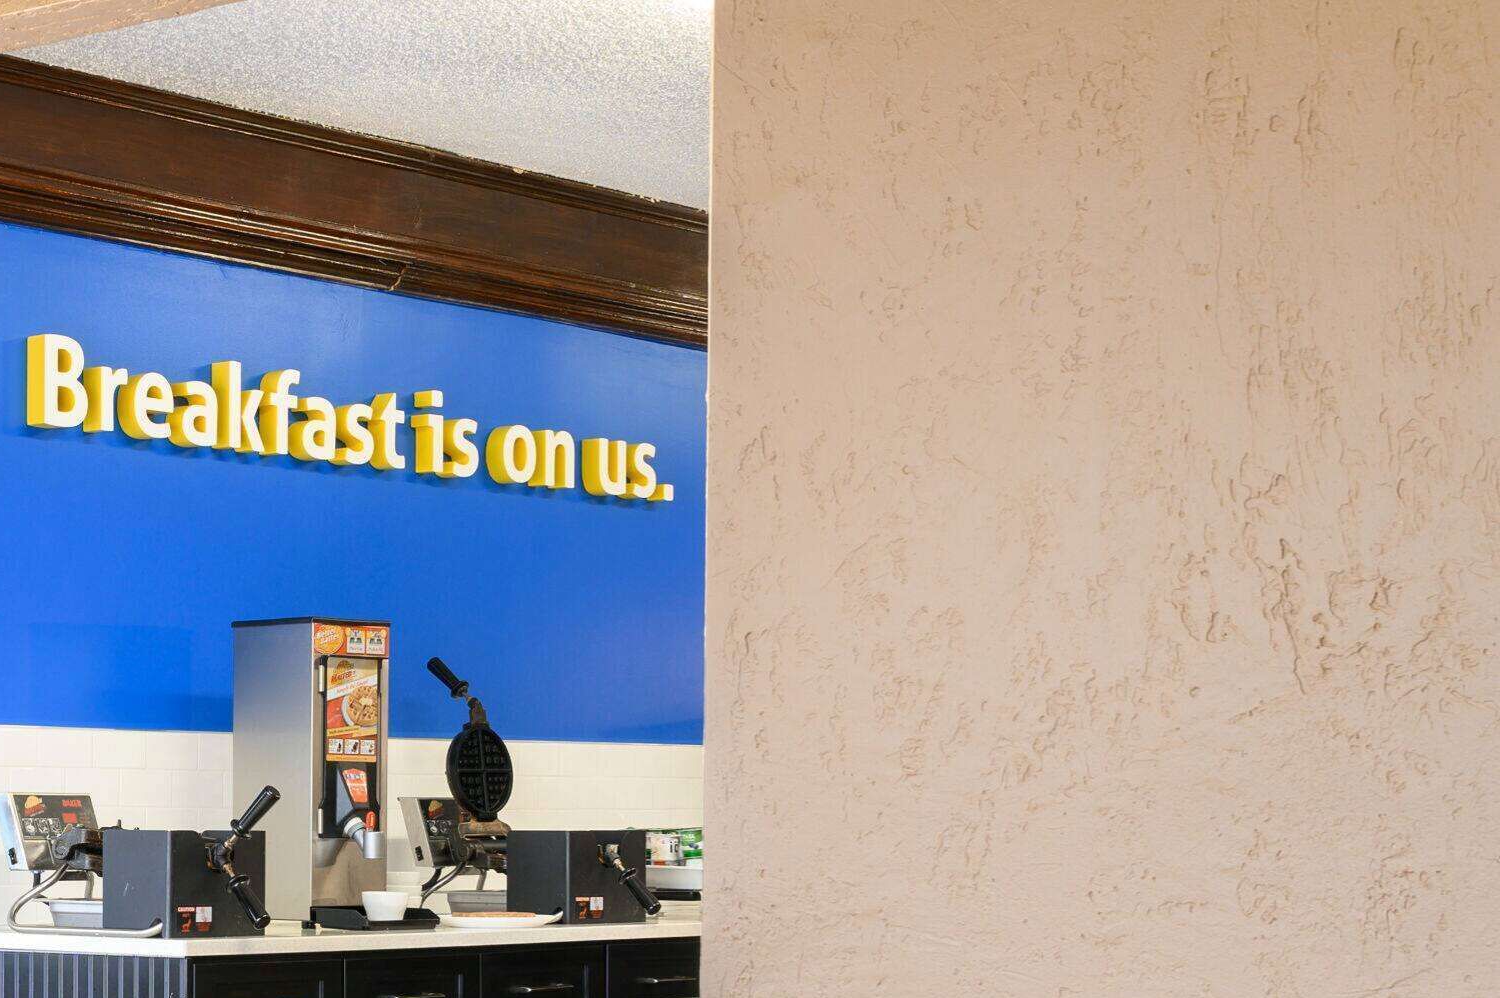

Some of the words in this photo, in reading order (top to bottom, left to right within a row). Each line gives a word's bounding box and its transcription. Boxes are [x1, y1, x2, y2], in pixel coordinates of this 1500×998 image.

[27, 334, 405, 469] Breakfast
[411, 390, 479, 477] is
[486, 425, 575, 488] on
[582, 438, 673, 501] us.
